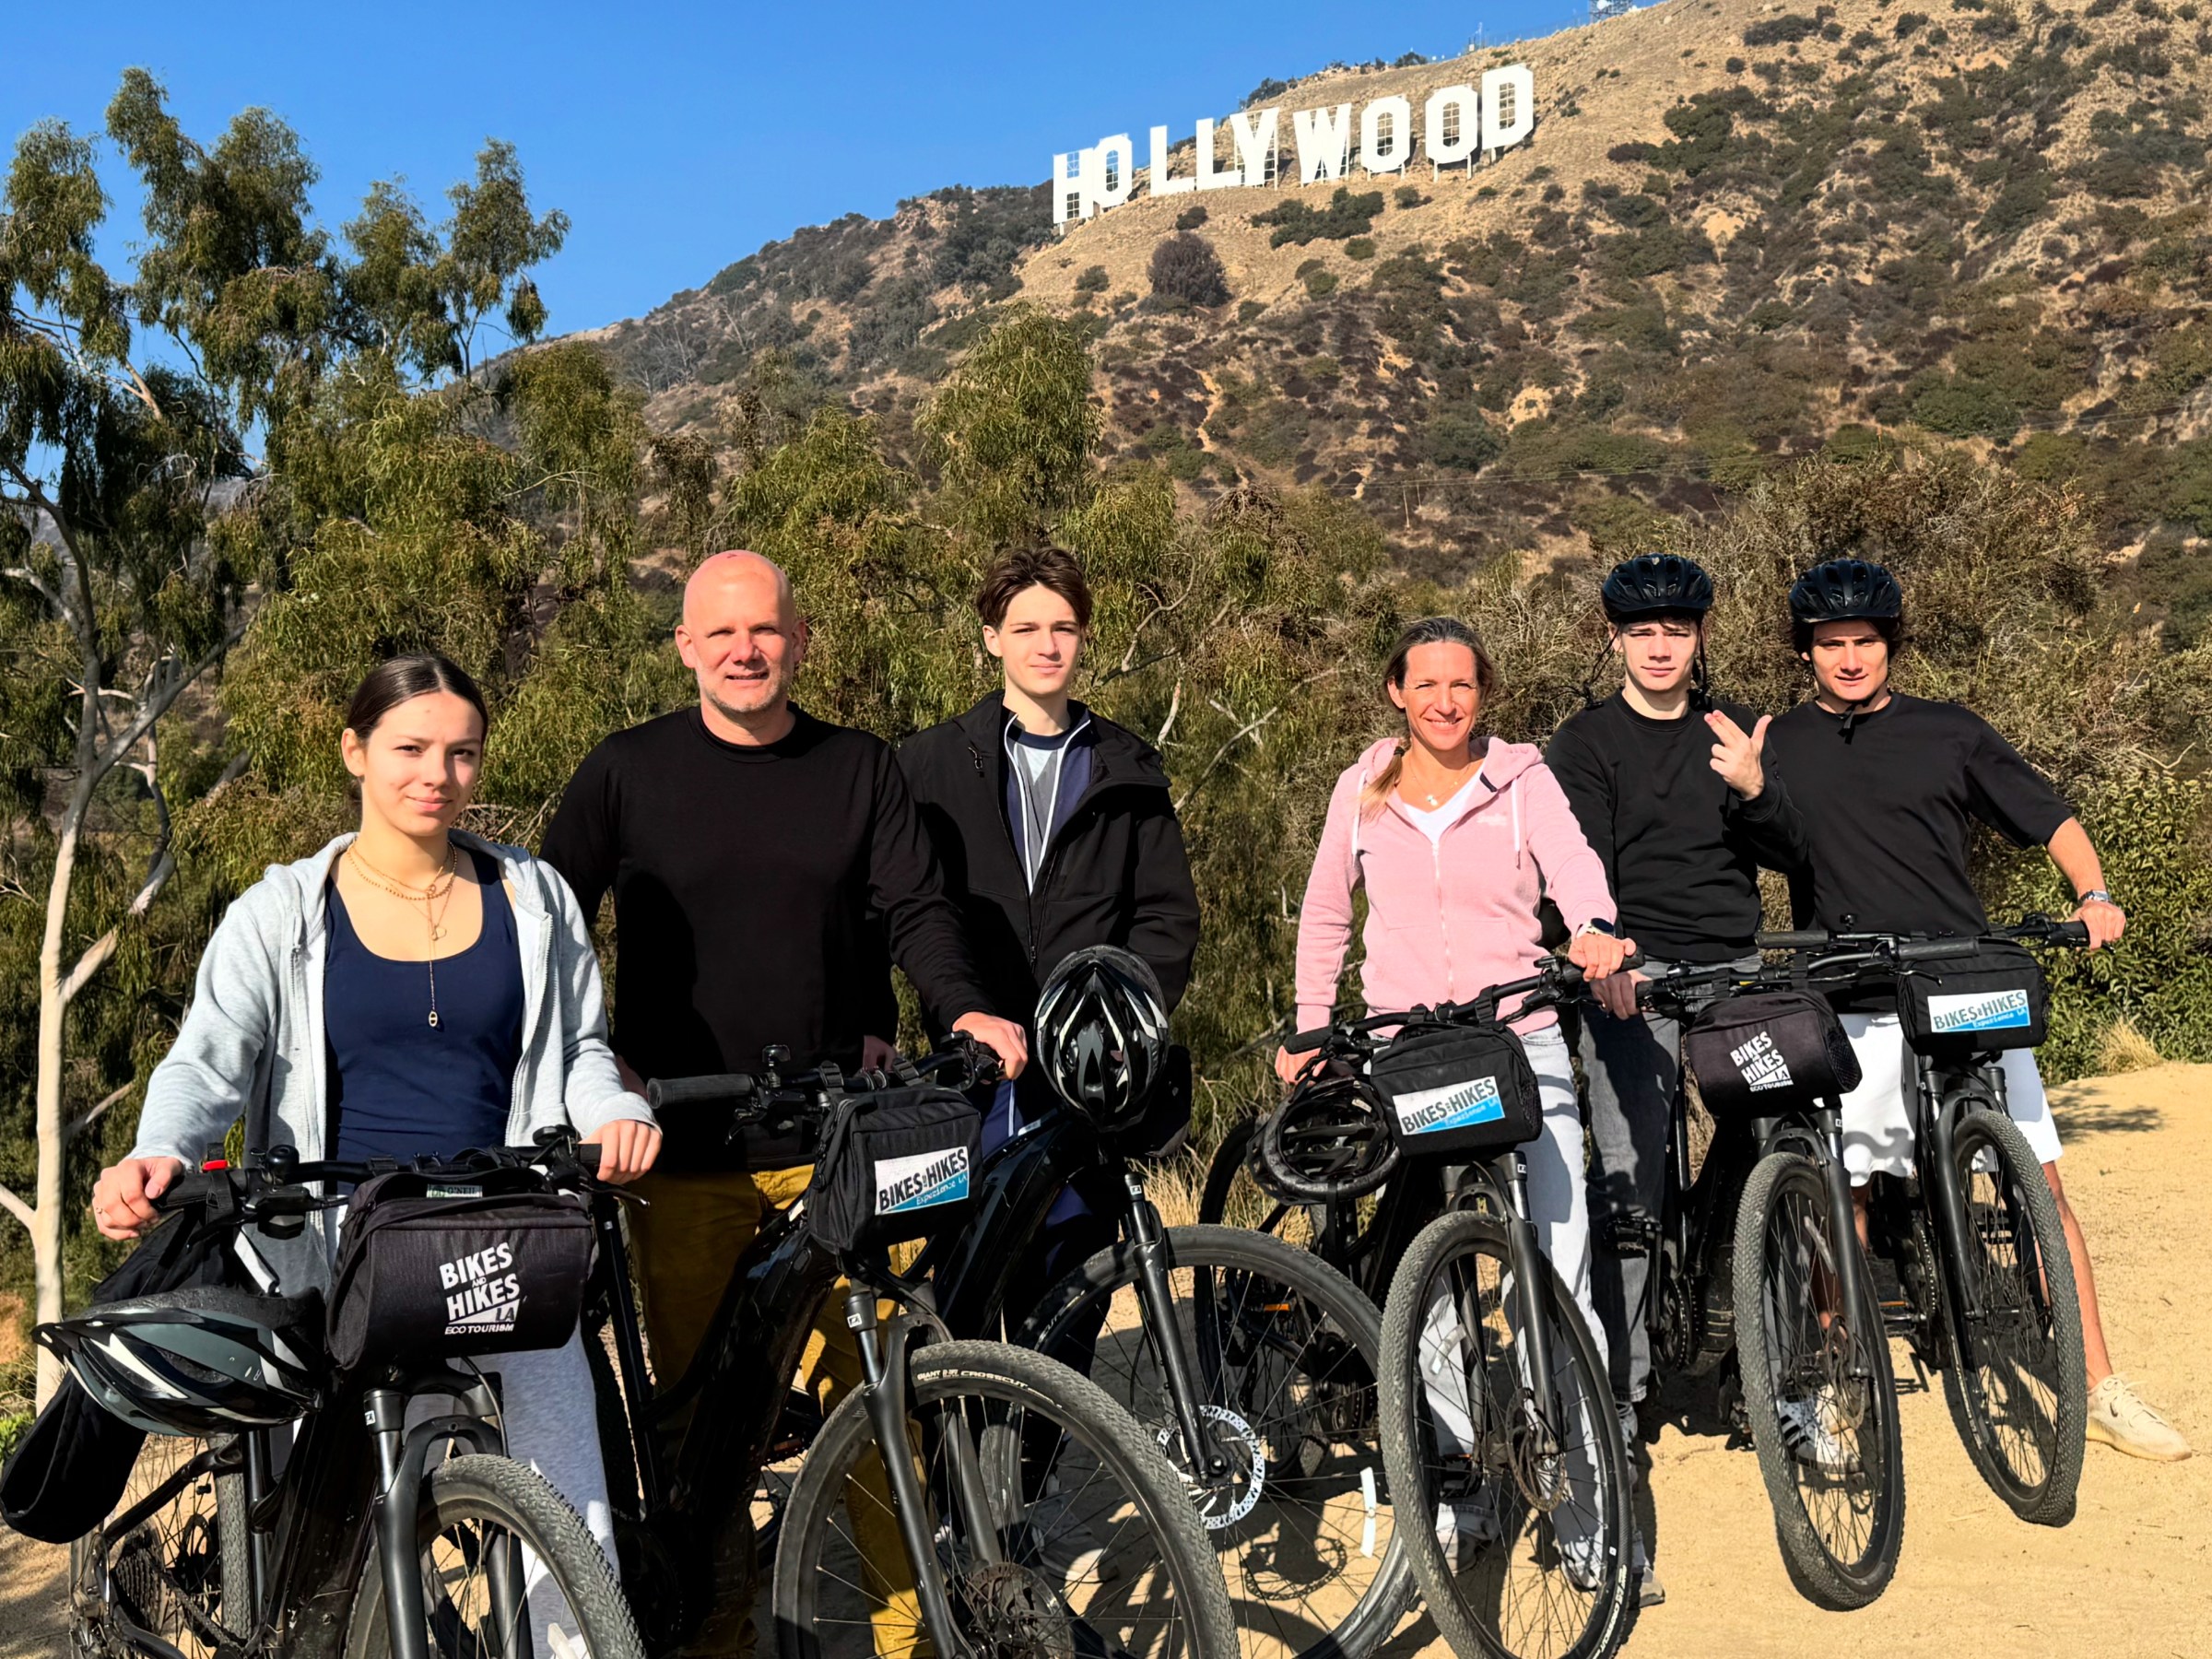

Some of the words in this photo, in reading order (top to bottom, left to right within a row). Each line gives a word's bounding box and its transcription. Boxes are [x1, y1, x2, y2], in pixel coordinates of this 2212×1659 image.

[1053, 64, 1533, 224] HOLLYWOOD
[1934, 1006, 1978, 1030] BIKES
[1982, 992, 2027, 1017] HIKES
[1730, 1031, 1772, 1066] BIKES
[1741, 1049, 1784, 1084] HIKES
[1401, 1101, 1448, 1133] BIKES
[1448, 1078, 1496, 1112] HIKES
[879, 1172, 924, 1212] BIKES
[925, 1148, 968, 1188] HIKES
[440, 1242, 513, 1289] BIKES
[472, 1277, 487, 1288] AND
[446, 1273, 521, 1321] HIKES
[495, 1308, 515, 1322] LA
[960, 1371, 1029, 1389] CROSSCUT
